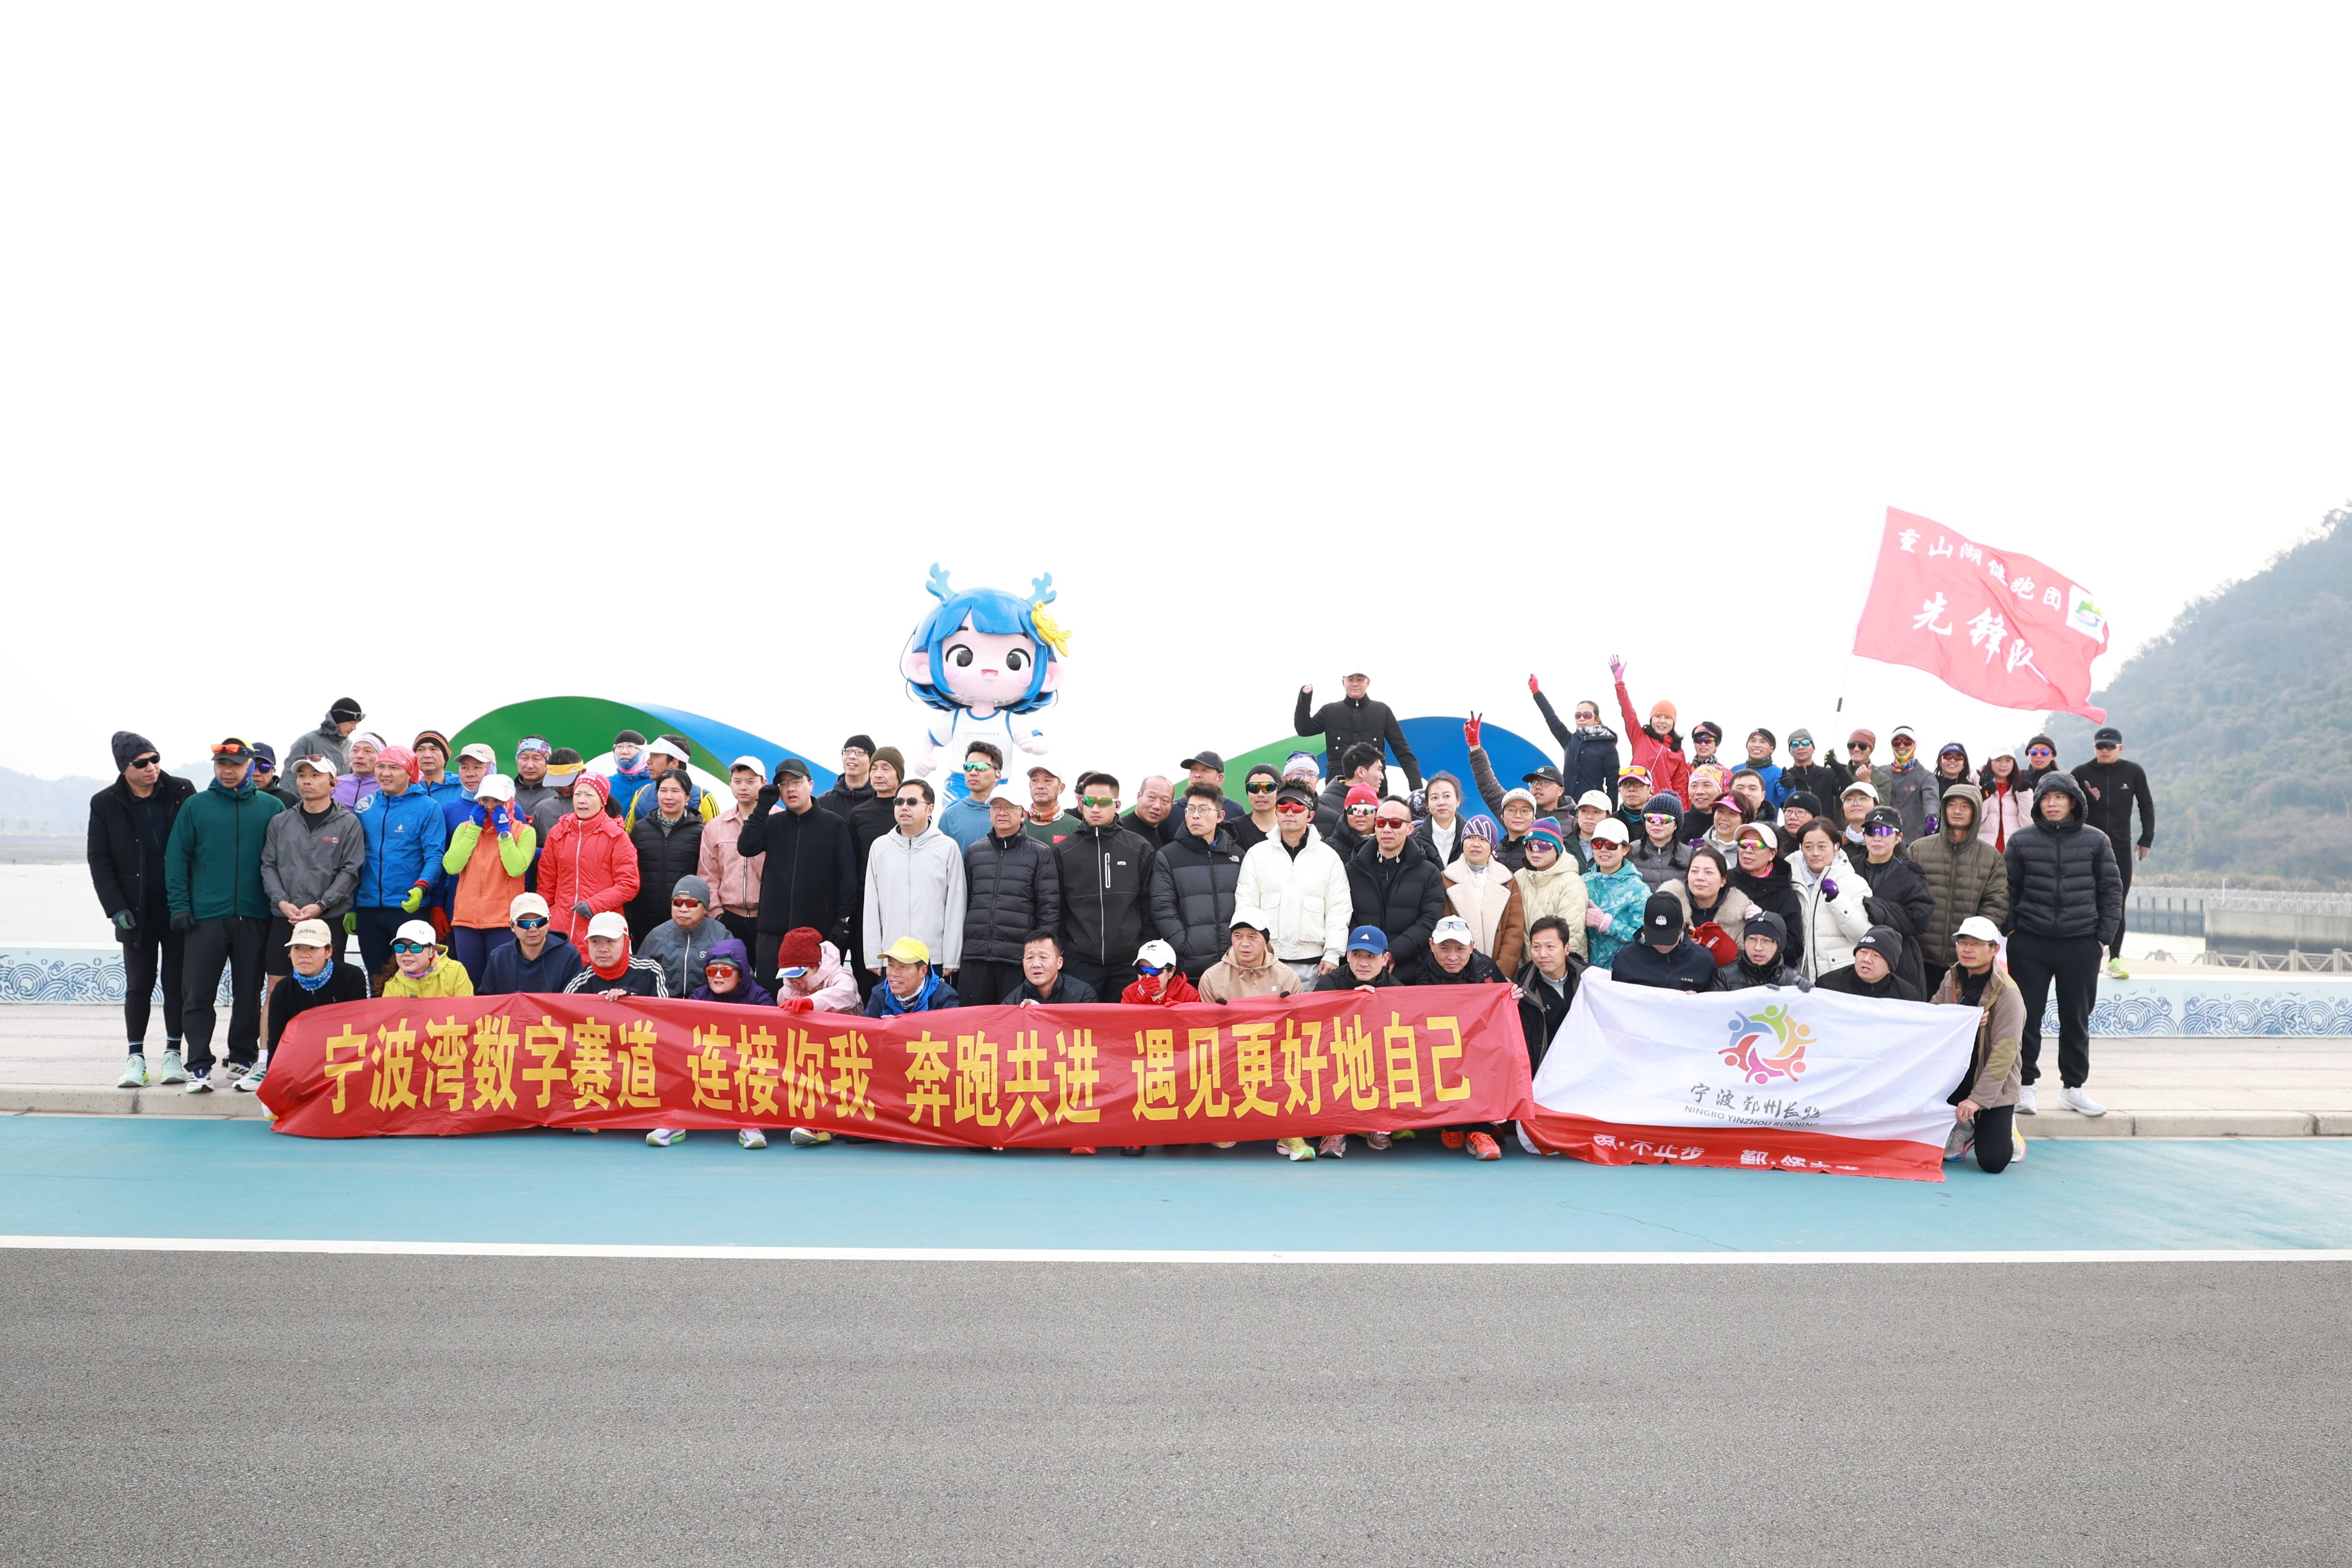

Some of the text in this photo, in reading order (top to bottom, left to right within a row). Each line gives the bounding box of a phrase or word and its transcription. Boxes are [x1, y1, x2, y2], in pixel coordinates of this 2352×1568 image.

[1913, 591, 2050, 684] 先锋队
[325, 1011, 1471, 1127] 宁波湾数字赛道 连接你我 奔跑共进 遇见更好地自己
[1684, 1105, 1725, 1120] NINGBO
[1727, 1114, 1771, 1126] YINZHOU
